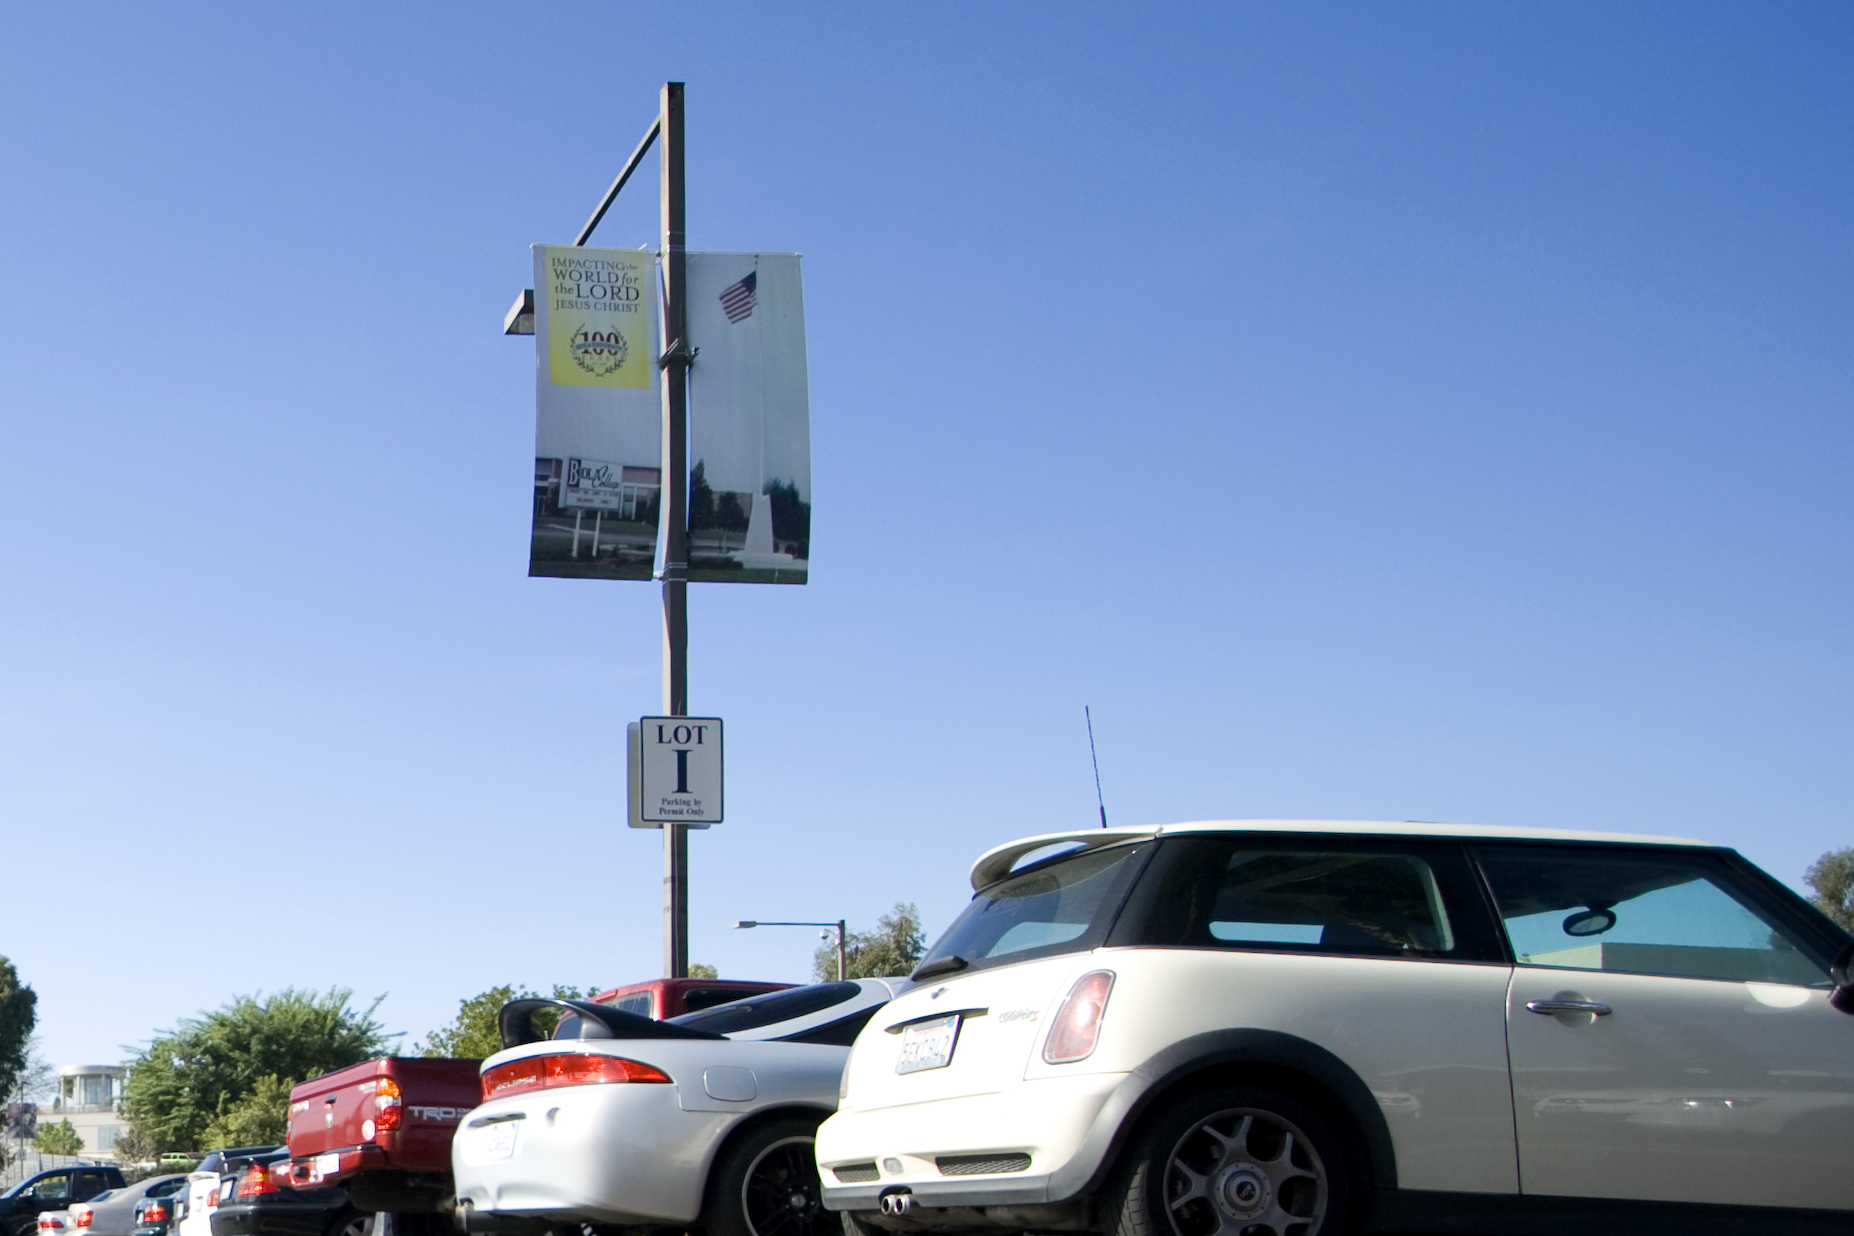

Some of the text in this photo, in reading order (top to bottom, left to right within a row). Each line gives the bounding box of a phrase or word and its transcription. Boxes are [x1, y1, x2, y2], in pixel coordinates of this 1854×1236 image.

[552, 257, 625, 271] IMPACTING
[553, 268, 639, 288] WORLD for
[555, 282, 640, 302] the LORD
[554, 299, 641, 313] JESUS CHRIST
[580, 330, 619, 356] 100
[657, 724, 708, 744] LOT
[672, 748, 693, 794] I
[661, 797, 702, 808] Parking by
[659, 807, 704, 817] Permit Only
[408, 1105, 456, 1121] TRD
